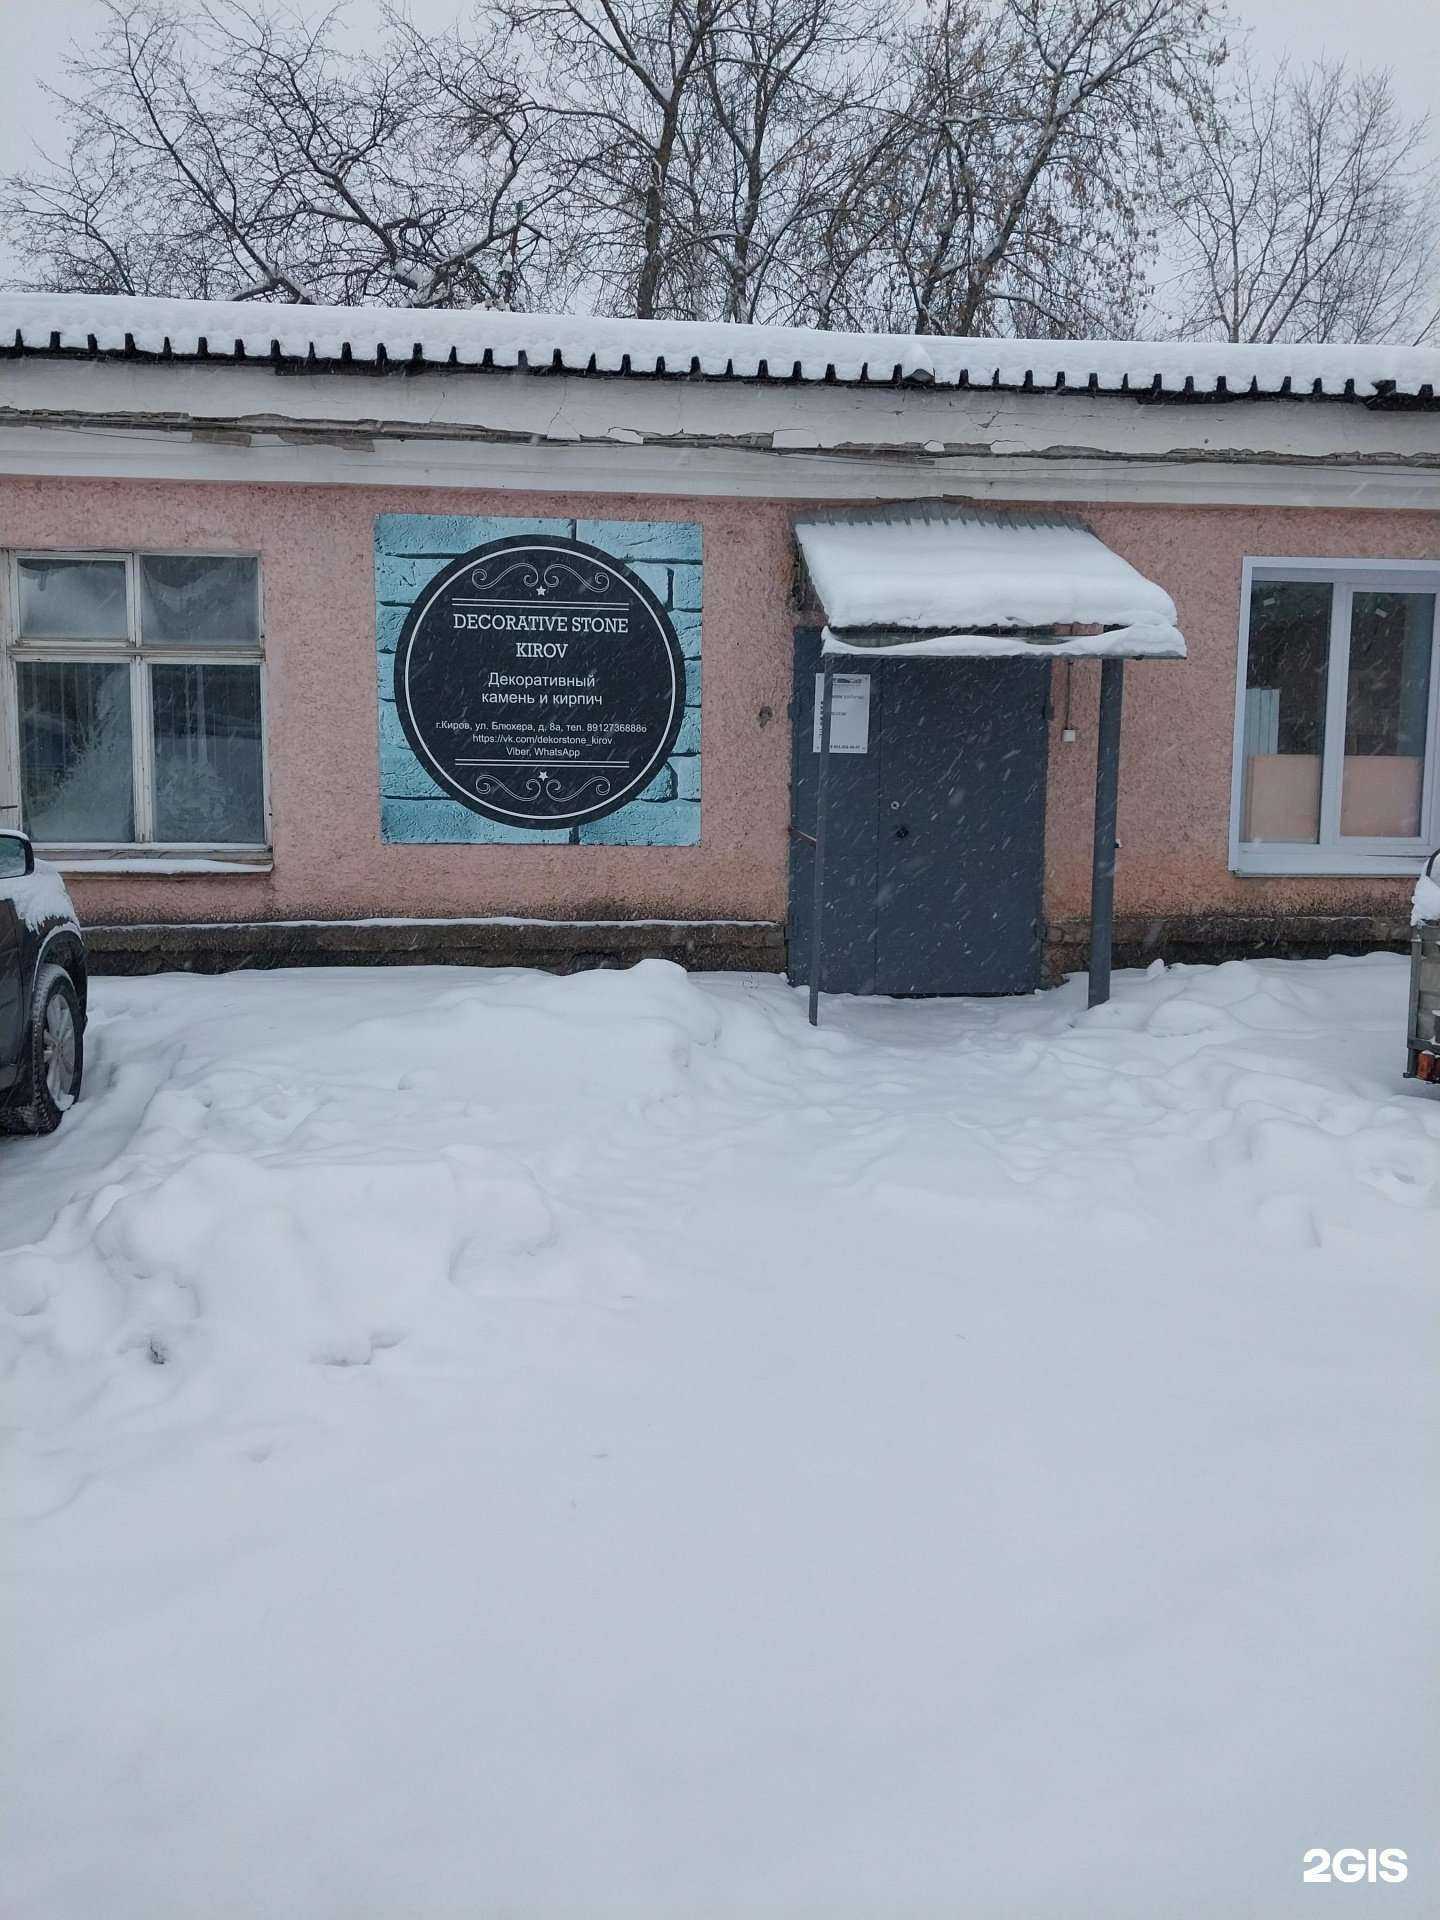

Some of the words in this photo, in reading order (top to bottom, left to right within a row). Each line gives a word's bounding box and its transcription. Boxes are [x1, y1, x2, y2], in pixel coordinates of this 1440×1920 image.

[453, 613, 568, 632] DECORATIVE
[571, 617, 629, 633] STONE
[515, 642, 568, 658] KIROV
[488, 672, 595, 688] Декоративный
[481, 692, 535, 704] камень
[539, 694, 548, 704] и
[552, 694, 603, 708] кирпич
[435, 721, 473, 731] г.Киров,
[475, 723, 489, 732] ул.
[491, 722, 536, 732] Блюхера,
[549, 723, 564, 732] 8а,
[506, 746, 532, 757] Viber,
[534, 748, 581, 758] WhatsApp
